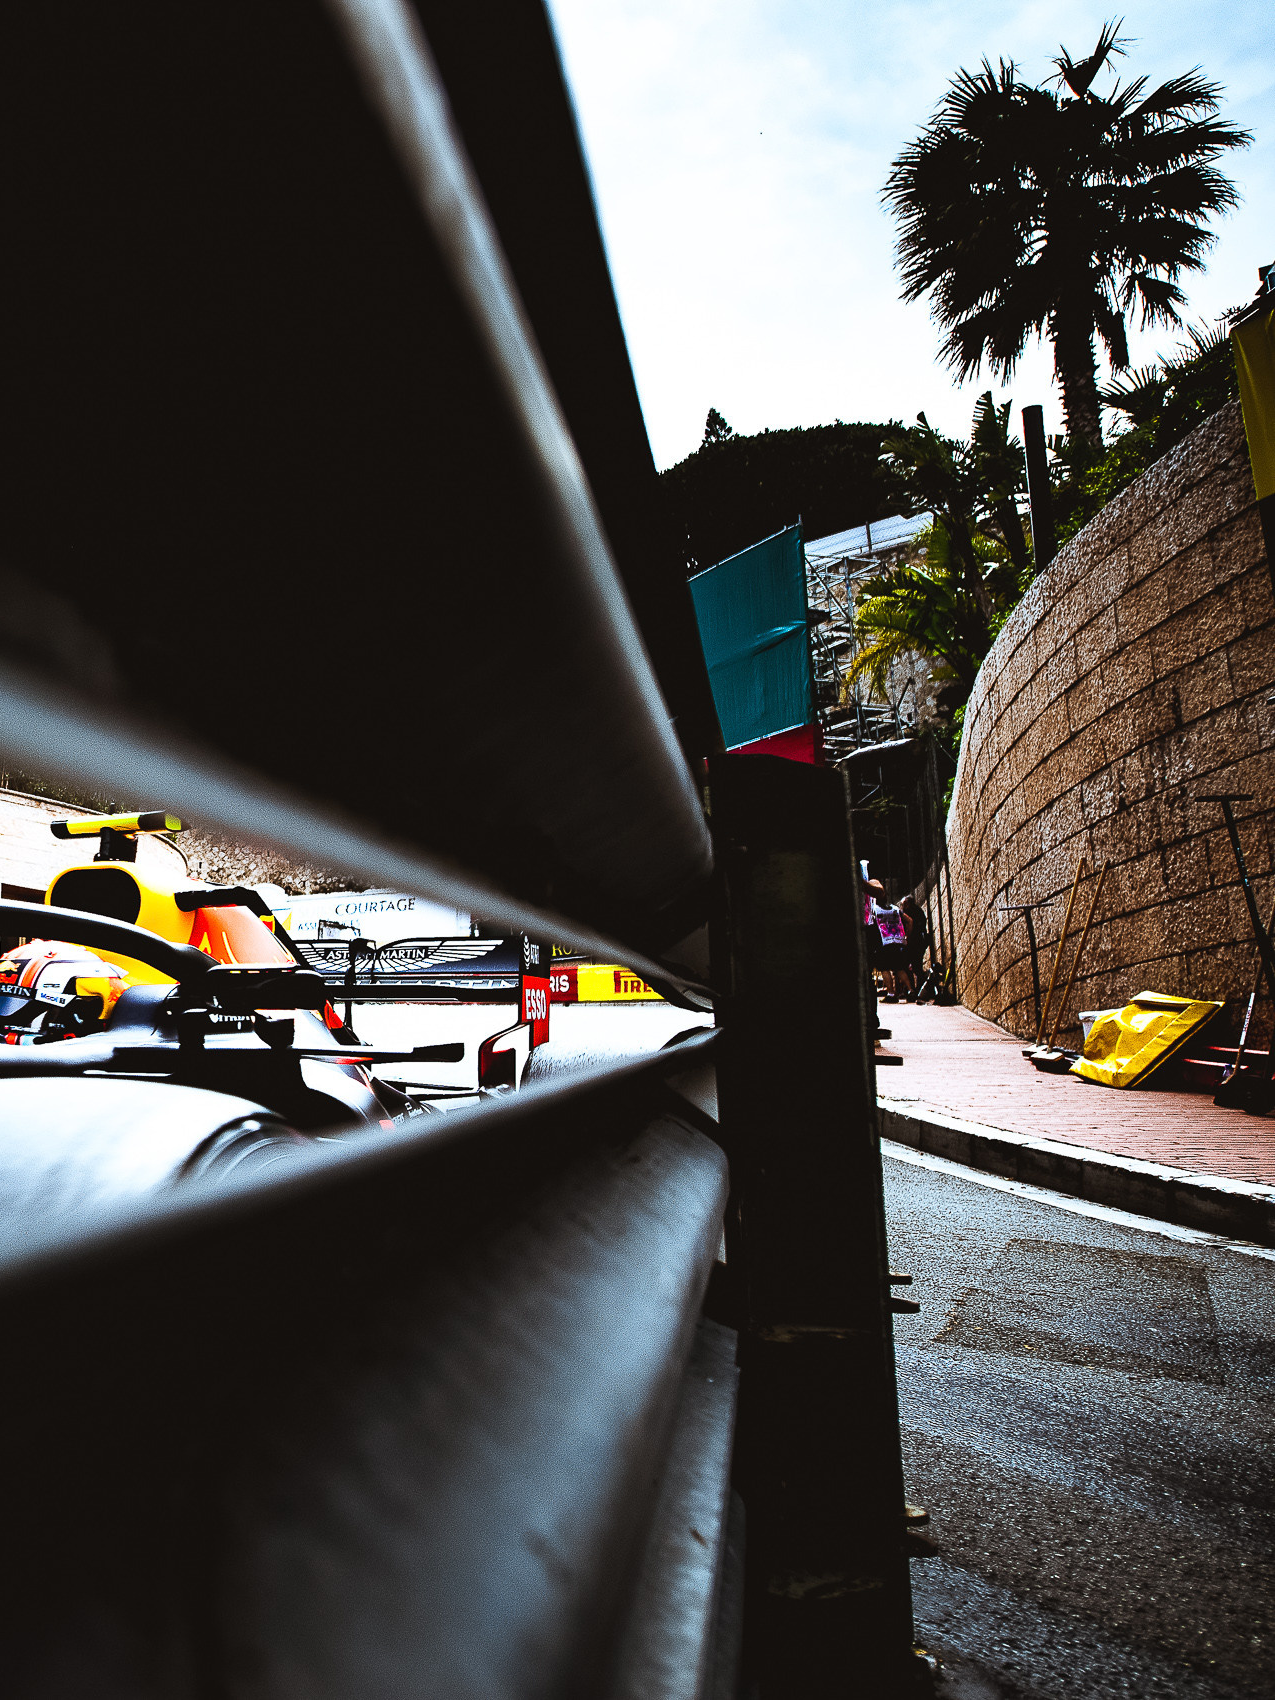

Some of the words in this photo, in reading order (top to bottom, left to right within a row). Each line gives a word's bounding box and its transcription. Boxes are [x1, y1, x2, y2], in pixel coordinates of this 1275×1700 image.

[334, 897, 416, 915] COURTAGE
[379, 949, 425, 960] MARTIN
[525, 988, 546, 1020] ESSO
